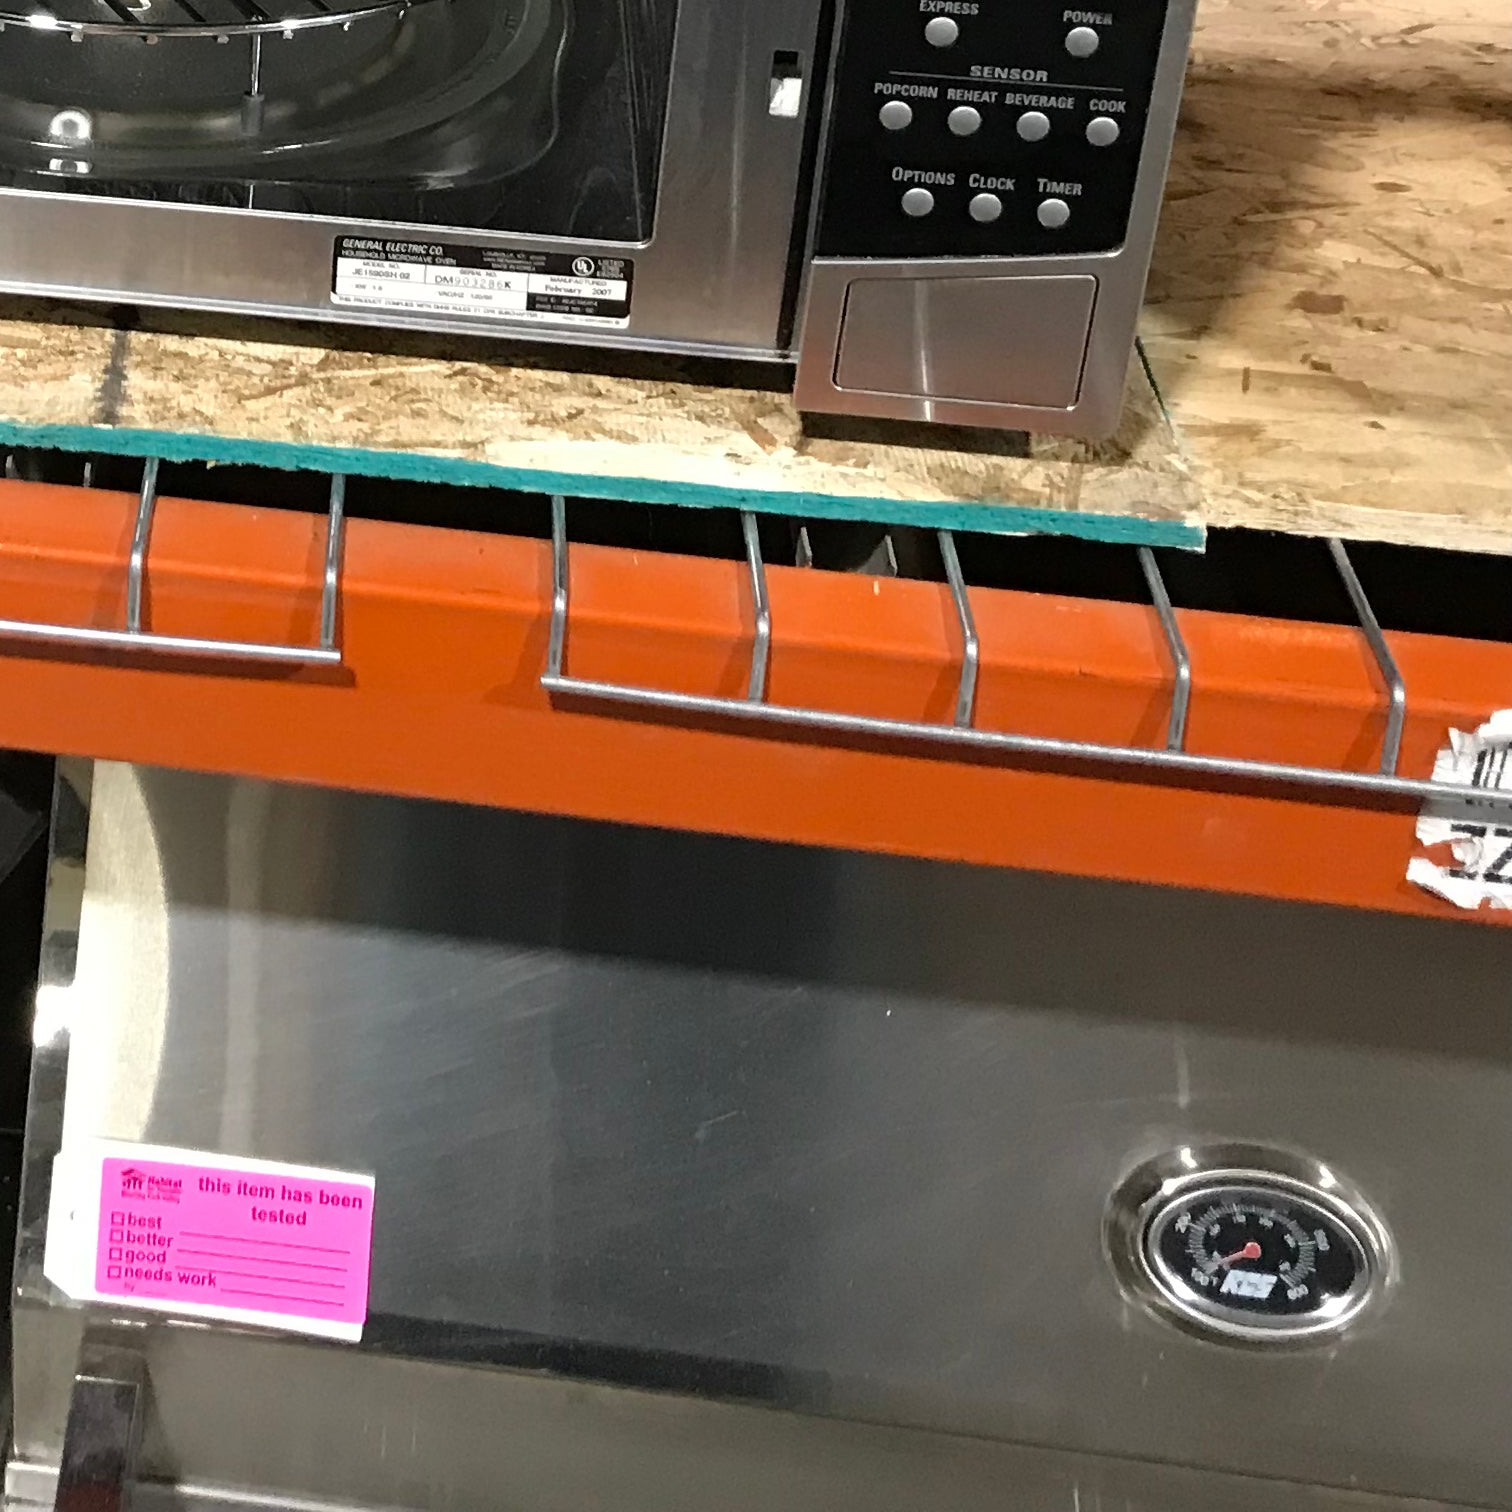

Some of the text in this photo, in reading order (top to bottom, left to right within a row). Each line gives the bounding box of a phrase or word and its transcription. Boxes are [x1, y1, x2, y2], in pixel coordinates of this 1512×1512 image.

[919, 0, 980, 16] EXPRESS
[1063, 9, 1114, 26] POWER
[969, 64, 1049, 83] SENSOR
[874, 81, 1127, 114] POPCORN REHEAT BEVERAGE COOK
[891, 166, 1083, 197] OPTIONS CLOCK TIMER
[342, 238, 383, 251] GENERAL
[385, 241, 428, 255] ELECTRIC
[545, 284, 613, 297] February 2007
[147, 1174, 183, 1188] Habitat
[198, 1176, 231, 1195] this
[237, 1180, 276, 1200] item
[280, 1184, 313, 1204] has
[319, 1189, 363, 1209] been
[127, 1212, 162, 1230] best
[251, 1206, 307, 1226] tested
[125, 1230, 174, 1249] better
[125, 1249, 167, 1265] good
[124, 1265, 217, 1288] needs work
